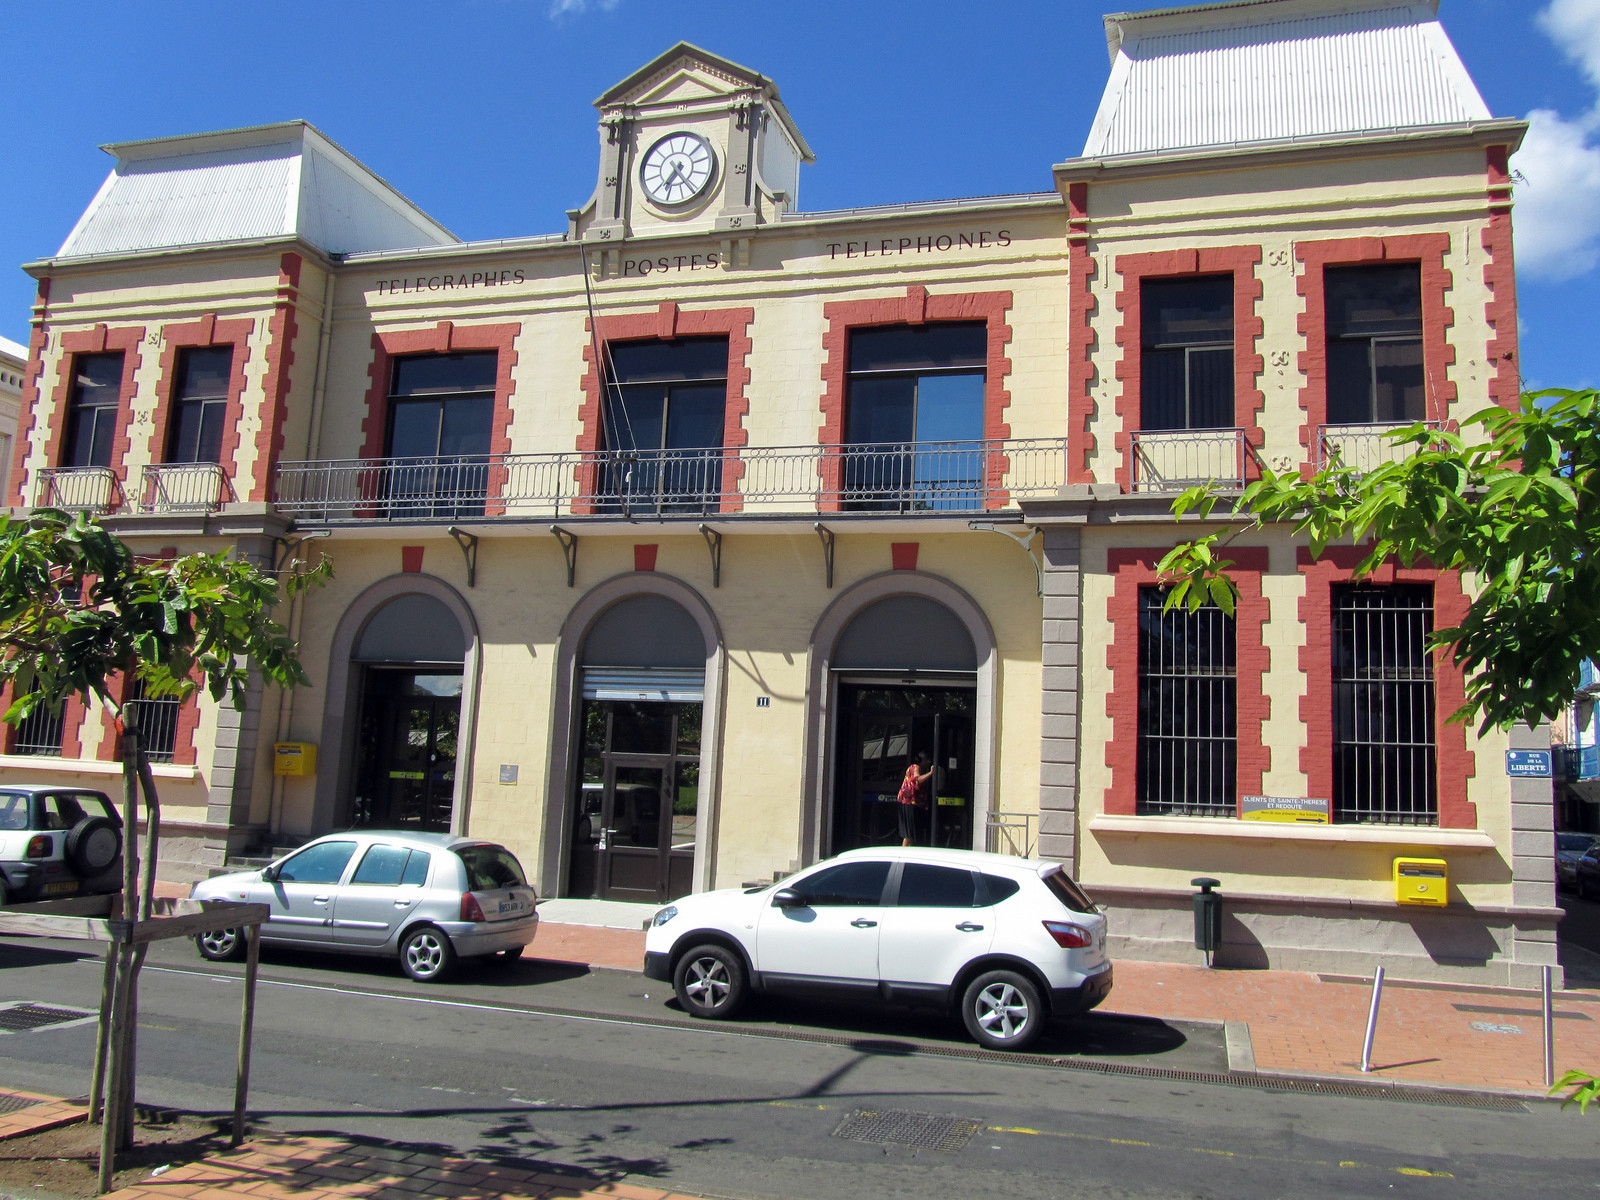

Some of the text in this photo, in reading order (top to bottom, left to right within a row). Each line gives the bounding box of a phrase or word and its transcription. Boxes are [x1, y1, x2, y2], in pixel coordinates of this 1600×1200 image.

[826, 230, 1011, 260] TELEPHONES
[624, 253, 718, 276] POSTES
[376, 269, 525, 296] TELEGRAPHES
[759, 697, 767, 706] 11
